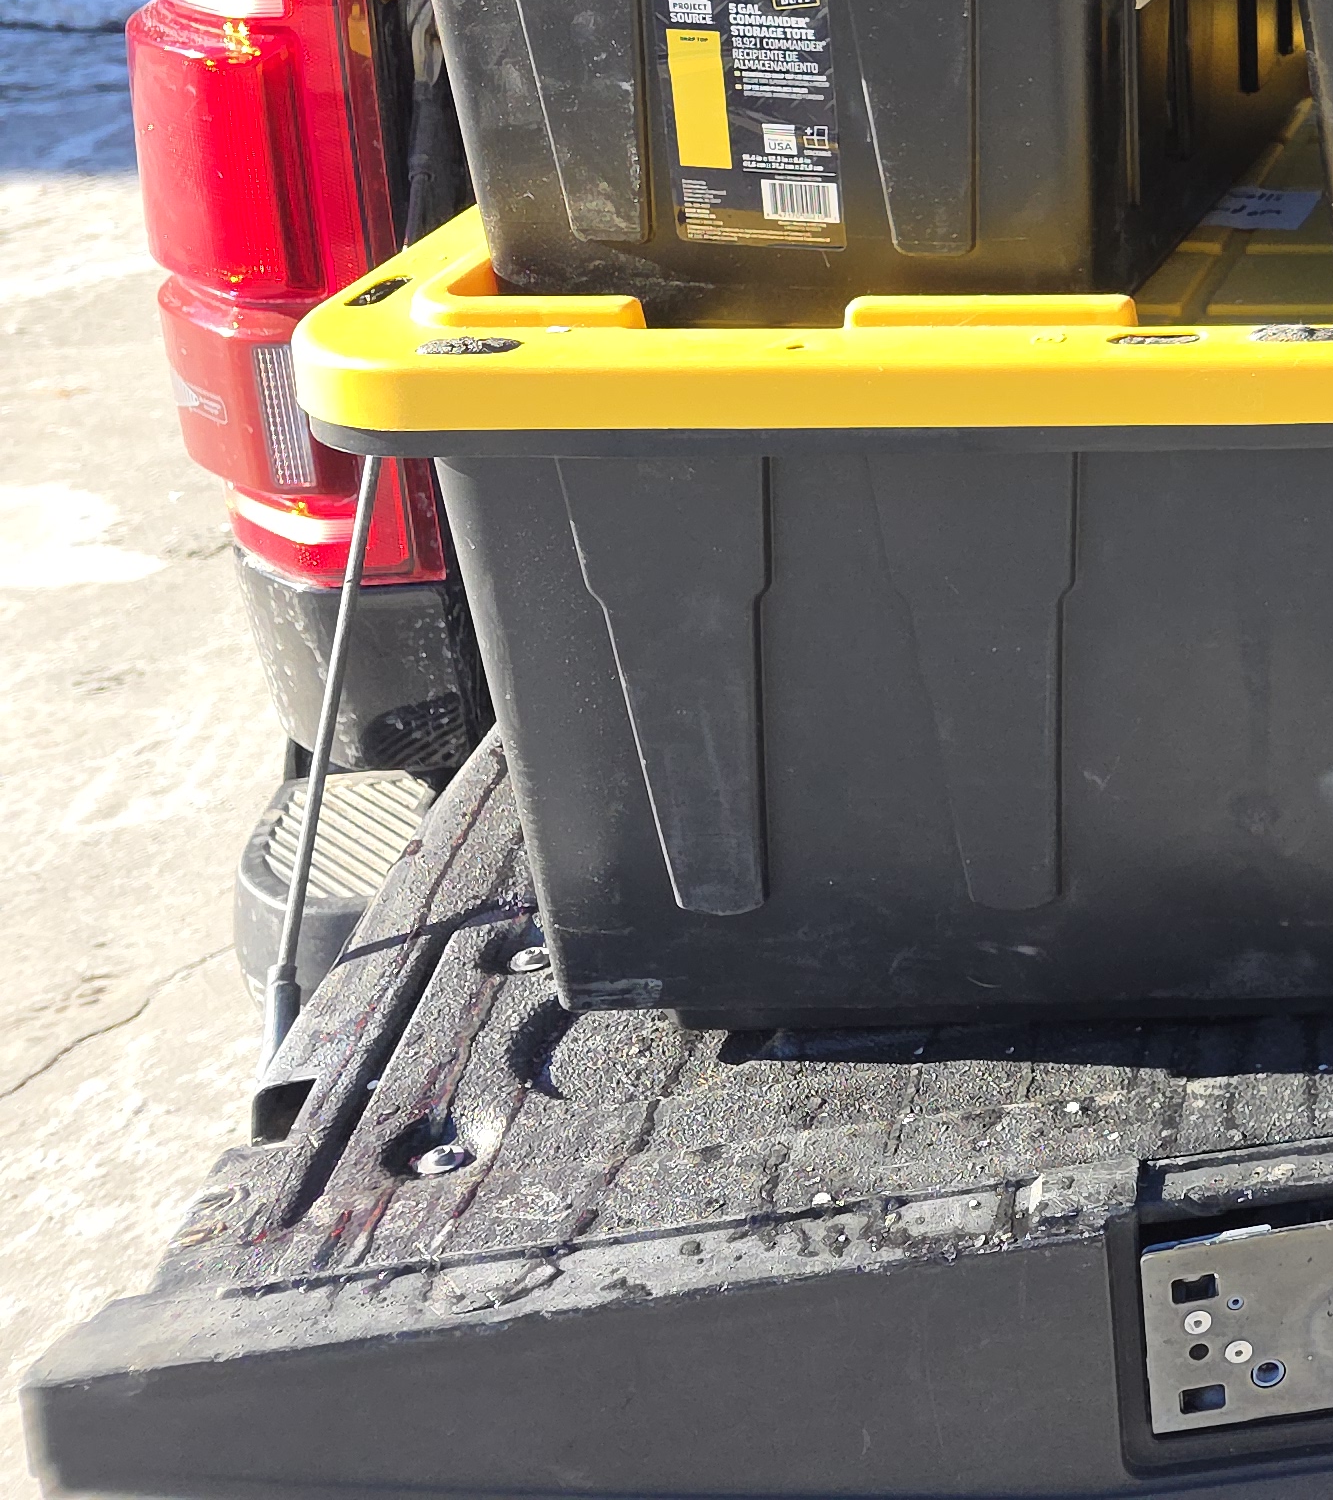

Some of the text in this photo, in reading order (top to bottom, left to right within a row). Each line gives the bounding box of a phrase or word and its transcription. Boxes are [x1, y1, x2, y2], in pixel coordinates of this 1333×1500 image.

[672, 2, 707, 11] PROJECT
[728, 2, 762, 15] 5 GAL
[670, 12, 713, 24] SOURCE
[730, 25, 815, 40] STORAGE TOTE
[732, 48, 800, 62] RECIPIENTE DE
[733, 59, 819, 73] ALMACENAMIENTO
[768, 142, 792, 151] USA
